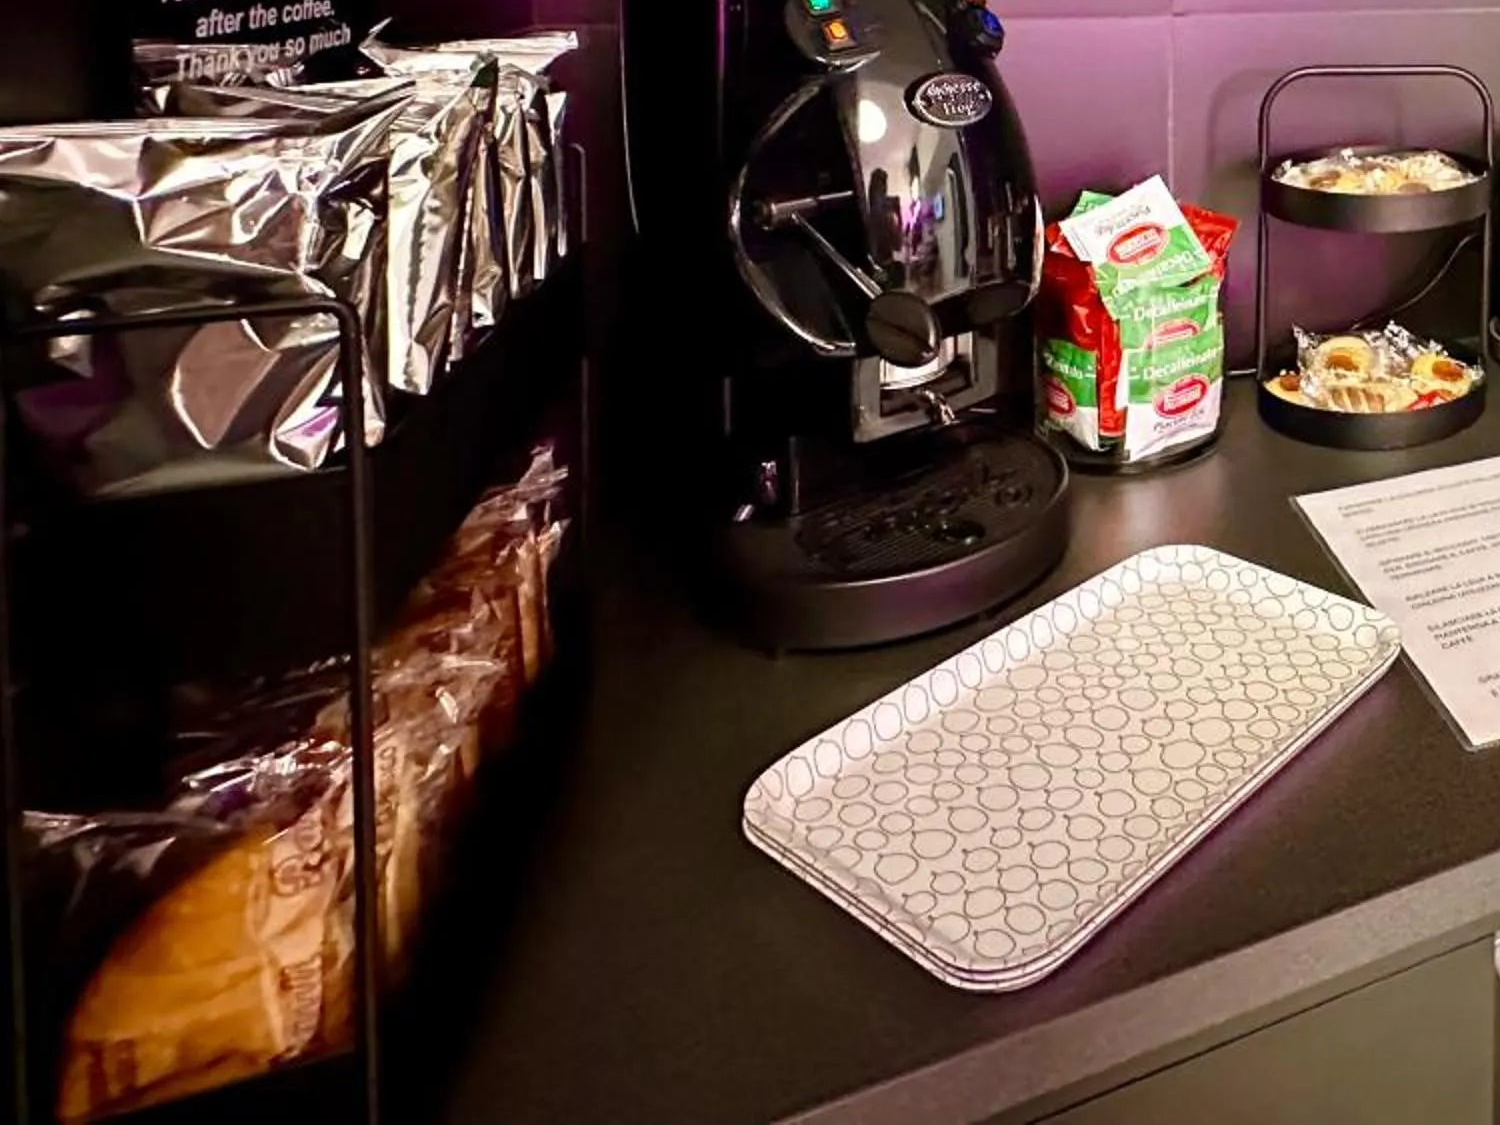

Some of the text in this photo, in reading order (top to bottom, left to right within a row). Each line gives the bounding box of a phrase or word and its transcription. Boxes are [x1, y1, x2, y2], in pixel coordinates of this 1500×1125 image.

[195, 8, 245, 38] after
[249, 3, 278, 29] the
[175, 45, 241, 81] Thank
[285, 36, 305, 58] so
[309, 23, 351, 54] much
